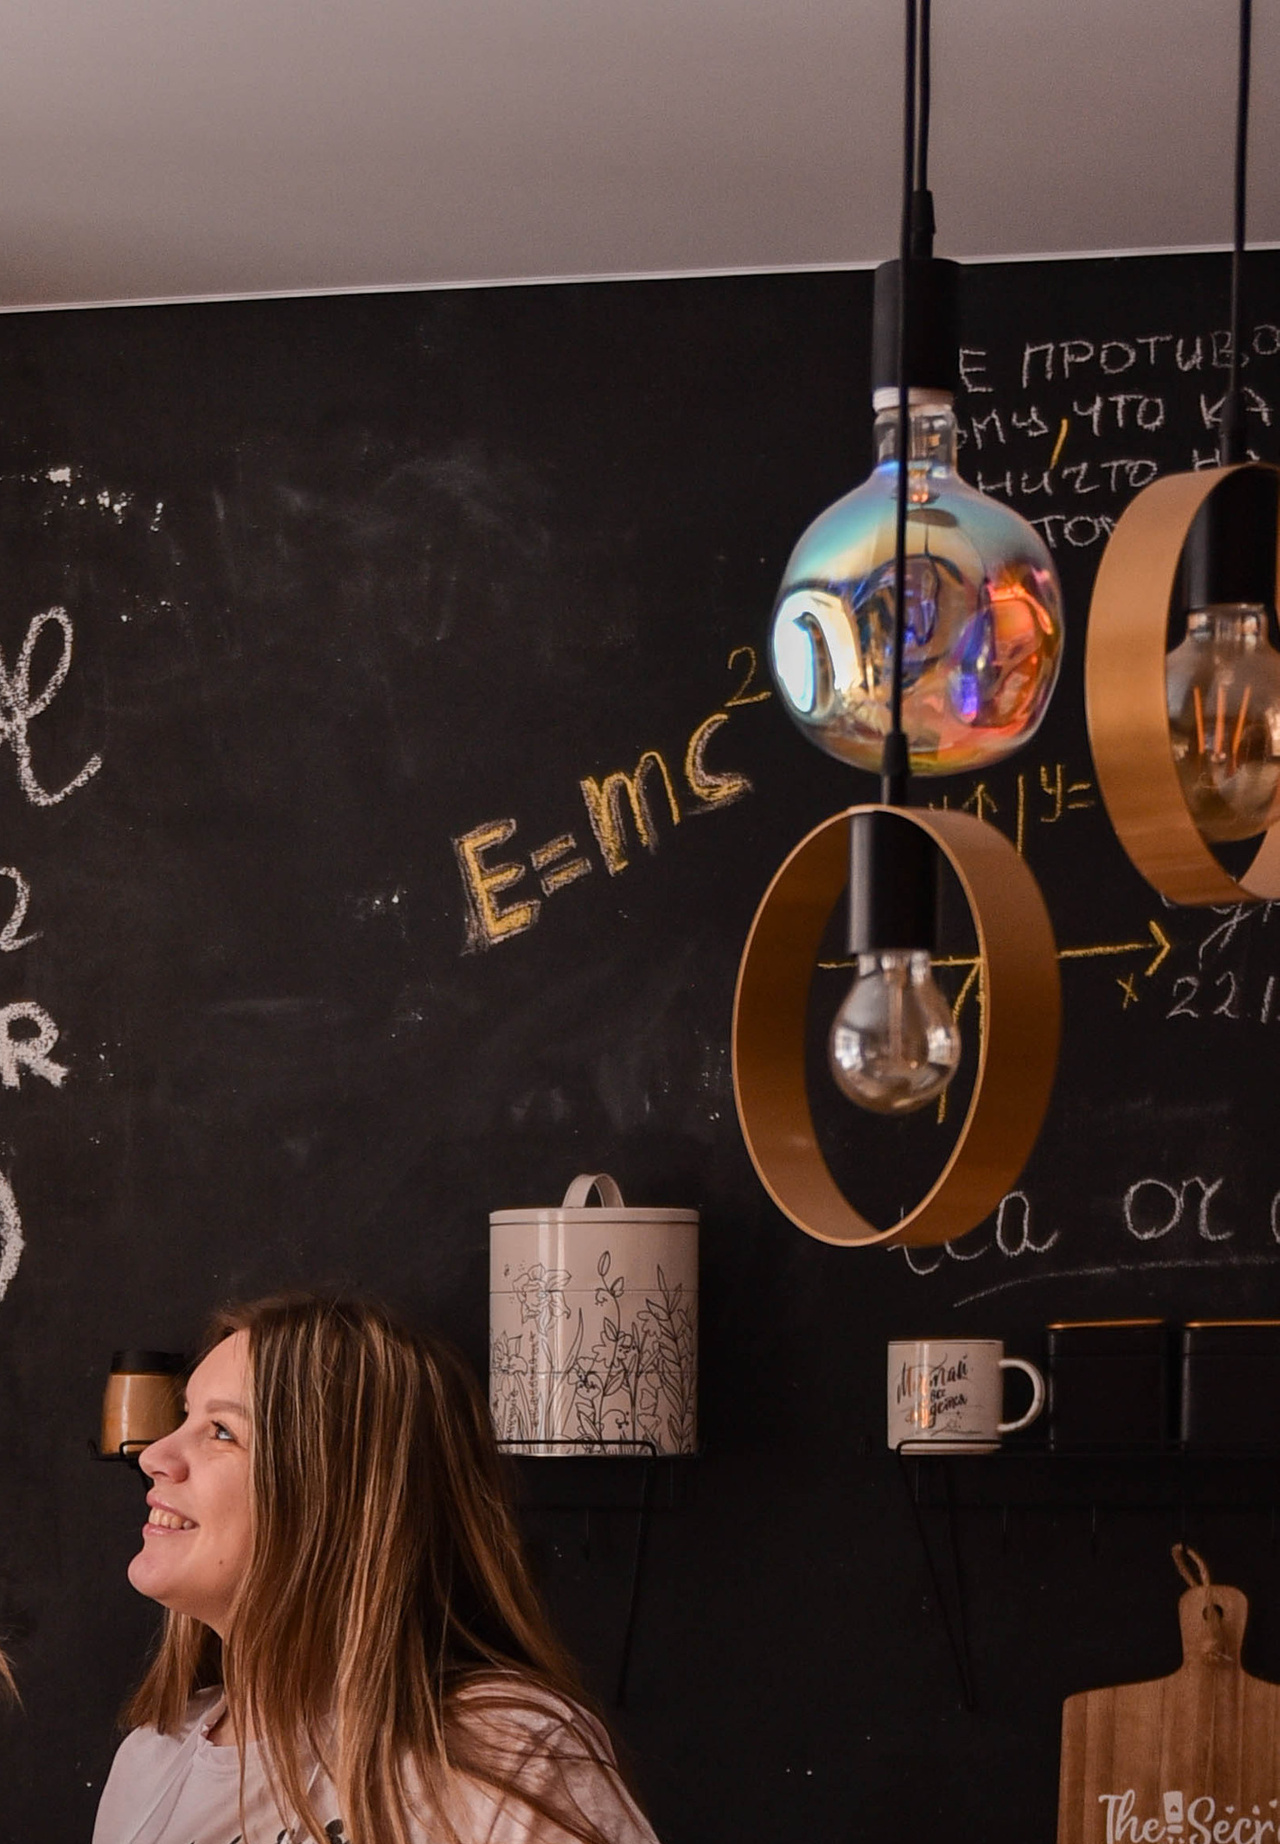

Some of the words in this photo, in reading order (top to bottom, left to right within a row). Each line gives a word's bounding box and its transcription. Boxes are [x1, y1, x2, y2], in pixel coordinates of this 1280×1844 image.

[959, 347, 993, 392] Е
[1073, 394, 1164, 436] ЧТО
[1125, 1177, 1234, 1241] or
